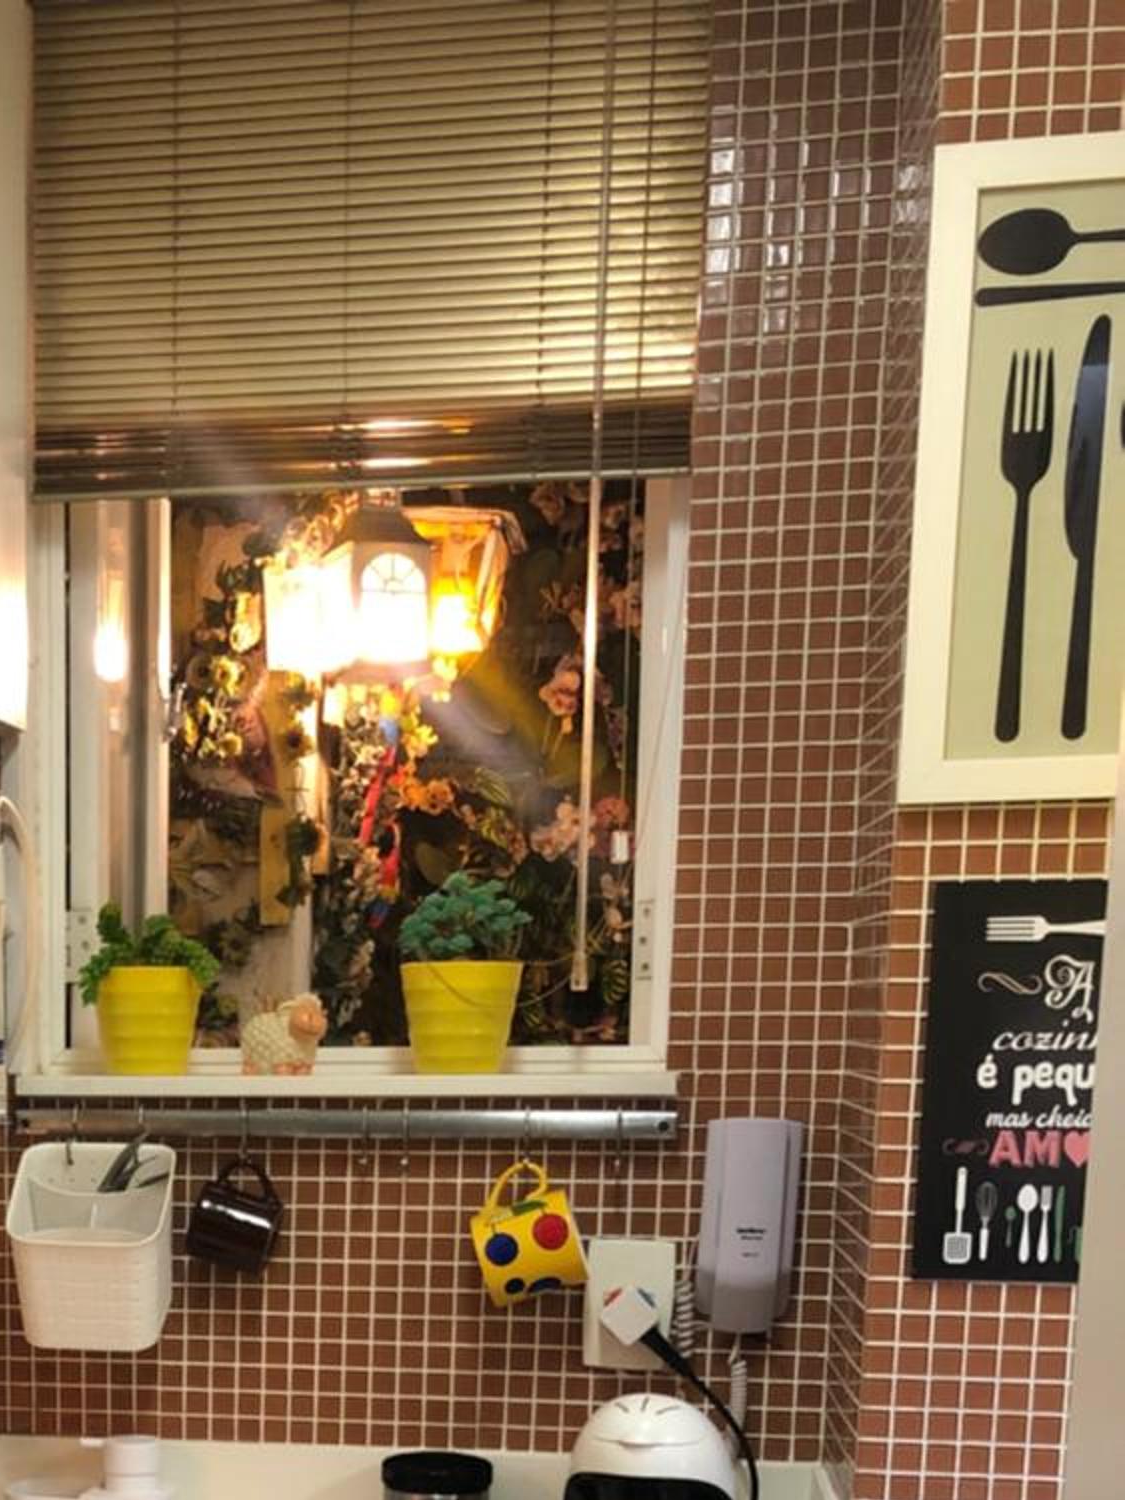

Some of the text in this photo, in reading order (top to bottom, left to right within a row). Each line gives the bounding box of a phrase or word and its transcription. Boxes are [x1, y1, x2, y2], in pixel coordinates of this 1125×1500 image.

[1044, 954, 1094, 1023] A
[976, 1053, 997, 1089] é
[985, 1111, 1033, 1128] mas
